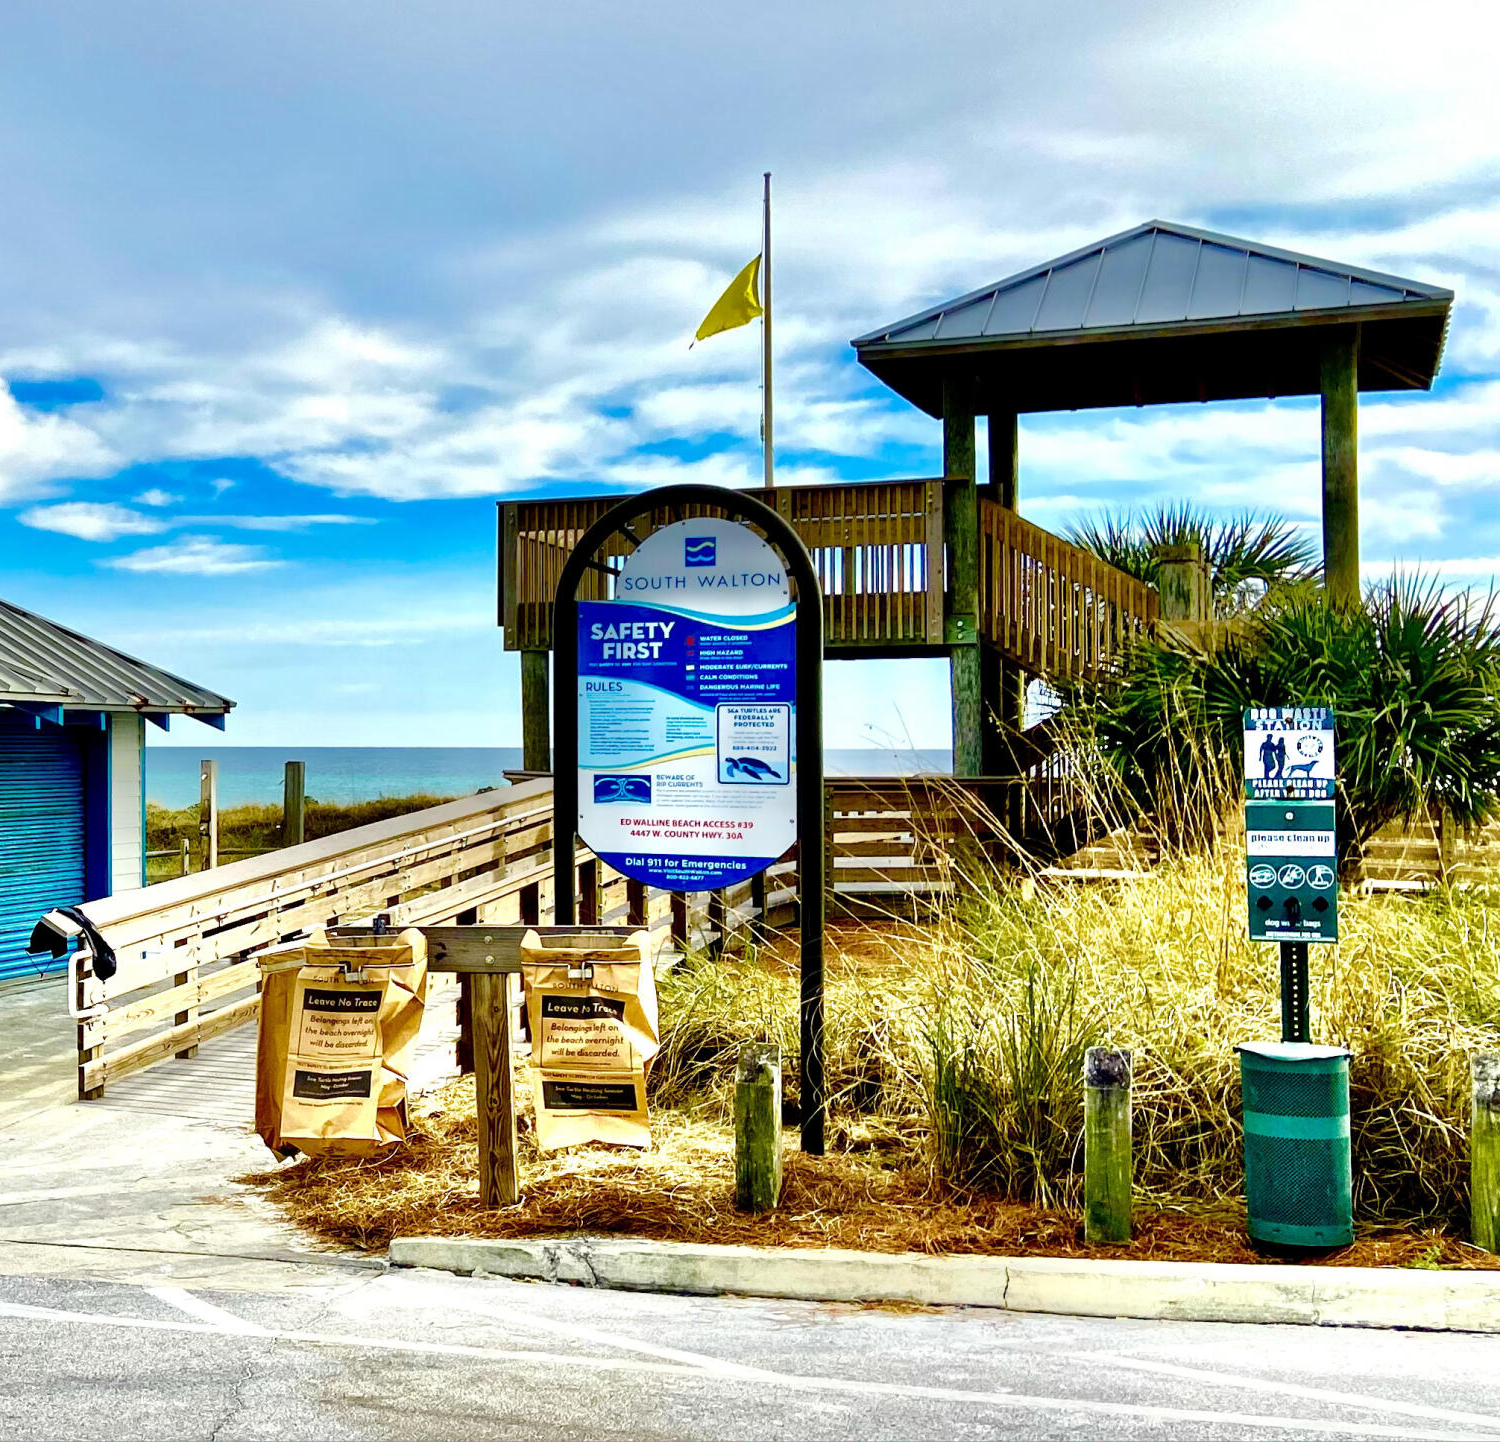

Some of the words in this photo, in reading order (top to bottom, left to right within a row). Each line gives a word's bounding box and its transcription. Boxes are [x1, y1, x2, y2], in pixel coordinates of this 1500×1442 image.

[624, 576, 686, 591] SOUTH
[697, 573, 781, 587] WALTON
[590, 621, 675, 640] SAFETY
[603, 642, 663, 659] FIRST
[586, 682, 623, 692] RULES
[1282, 708, 1327, 720] WASTE
[1316, 779, 1328, 788] UP
[620, 818, 631, 826] ED
[633, 819, 670, 827] WALLINE
[672, 820, 701, 828] BEACH
[703, 820, 735, 828] ACCESS
[737, 821, 754, 829] #39
[630, 829, 650, 837] 4447
[664, 830, 700, 838] COUNTY
[702, 831, 724, 839] HWY.
[726, 832, 743, 840] 30A
[1251, 834, 1285, 842] please
[1287, 834, 1315, 842] clean
[1317, 835, 1330, 843] up
[625, 857, 645, 866] Dial
[647, 858, 662, 867] 911
[664, 858, 679, 867] for
[681, 859, 747, 870] Emergencies
[1303, 919, 1321, 929] bags
[308, 995, 336, 1007] Leave
[338, 997, 352, 1007] No
[354, 997, 378, 1007] Trace
[547, 1002, 579, 1013] Leave
[592, 1002, 618, 1016] Trace
[310, 1015, 350, 1025] Belongings
[351, 1016, 363, 1026] left
[305, 1026, 318, 1035] the
[320, 1028, 342, 1036] beach
[343, 1028, 375, 1038] overnight
[551, 1022, 593, 1034] Belongings
[593, 1022, 606, 1033] left
[310, 1039, 323, 1048] will
[324, 1039, 334, 1048] be
[546, 1035, 559, 1043] the
[561, 1035, 584, 1044] beach
[585, 1035, 624, 1046] overnight
[551, 1048, 564, 1056] will
[565, 1048, 576, 1056] be
[577, 1048, 620, 1057] discarded.
